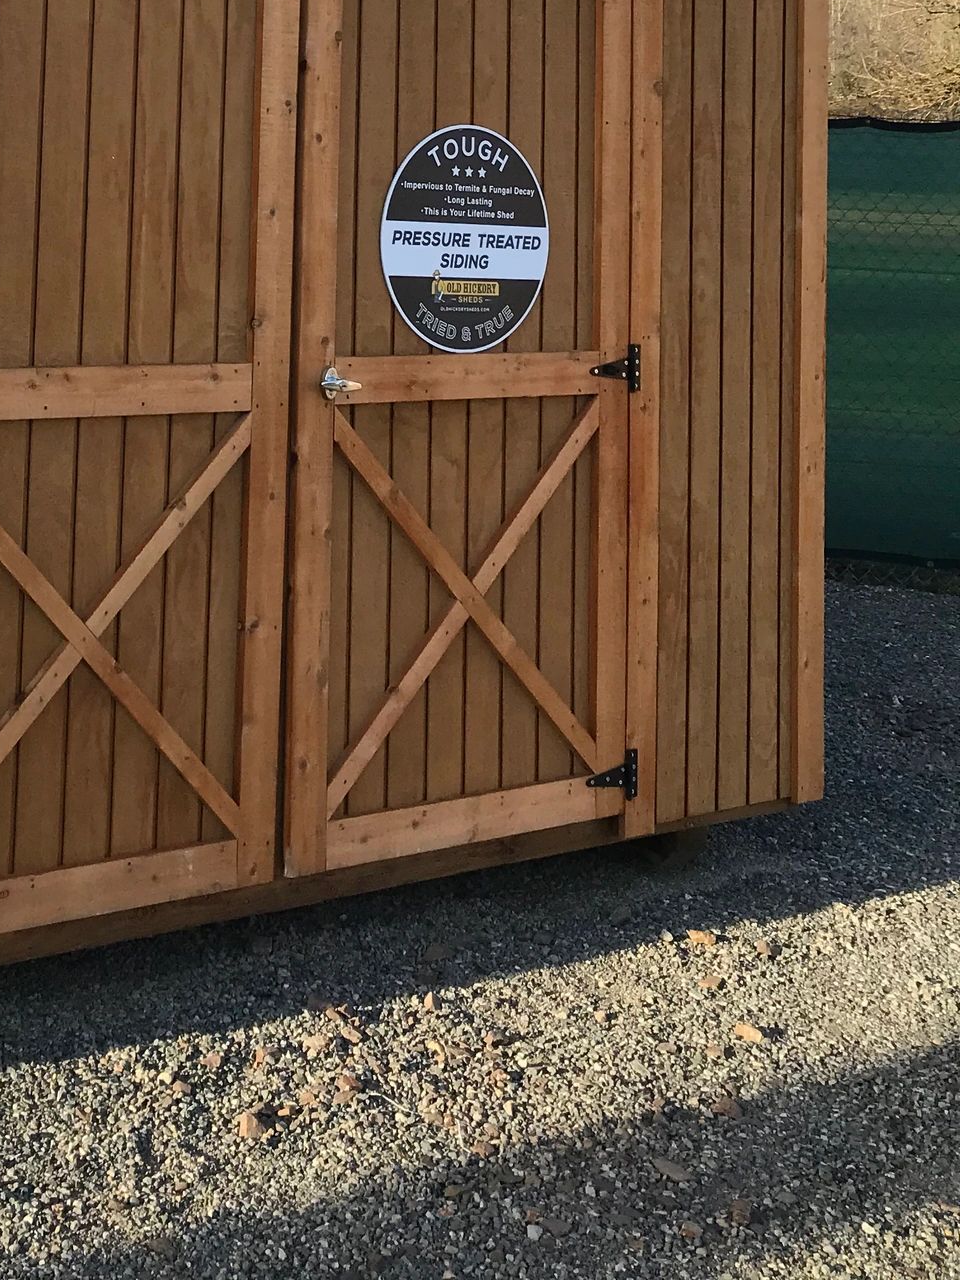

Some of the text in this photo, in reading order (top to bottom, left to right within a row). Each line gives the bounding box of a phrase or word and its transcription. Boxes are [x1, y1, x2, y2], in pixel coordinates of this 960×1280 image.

[427, 136, 509, 173] TOUGH
[445, 182, 453, 192] to
[454, 183, 480, 194] Termite
[481, 185, 487, 194] &
[489, 185, 512, 196] Fungal
[513, 187, 535, 198] Decay
[467, 197, 493, 208] Lasting
[441, 207, 448, 217] is
[449, 208, 466, 218] Your
[467, 209, 496, 219] Lifetime
[496, 210, 515, 220] Shed
[392, 230, 541, 250] PRESSURE TREATED
[440, 253, 489, 269] SIDING
[446, 282, 497, 294] OLD HICKORY
[416, 302, 515, 342] TRIED & TRUE
